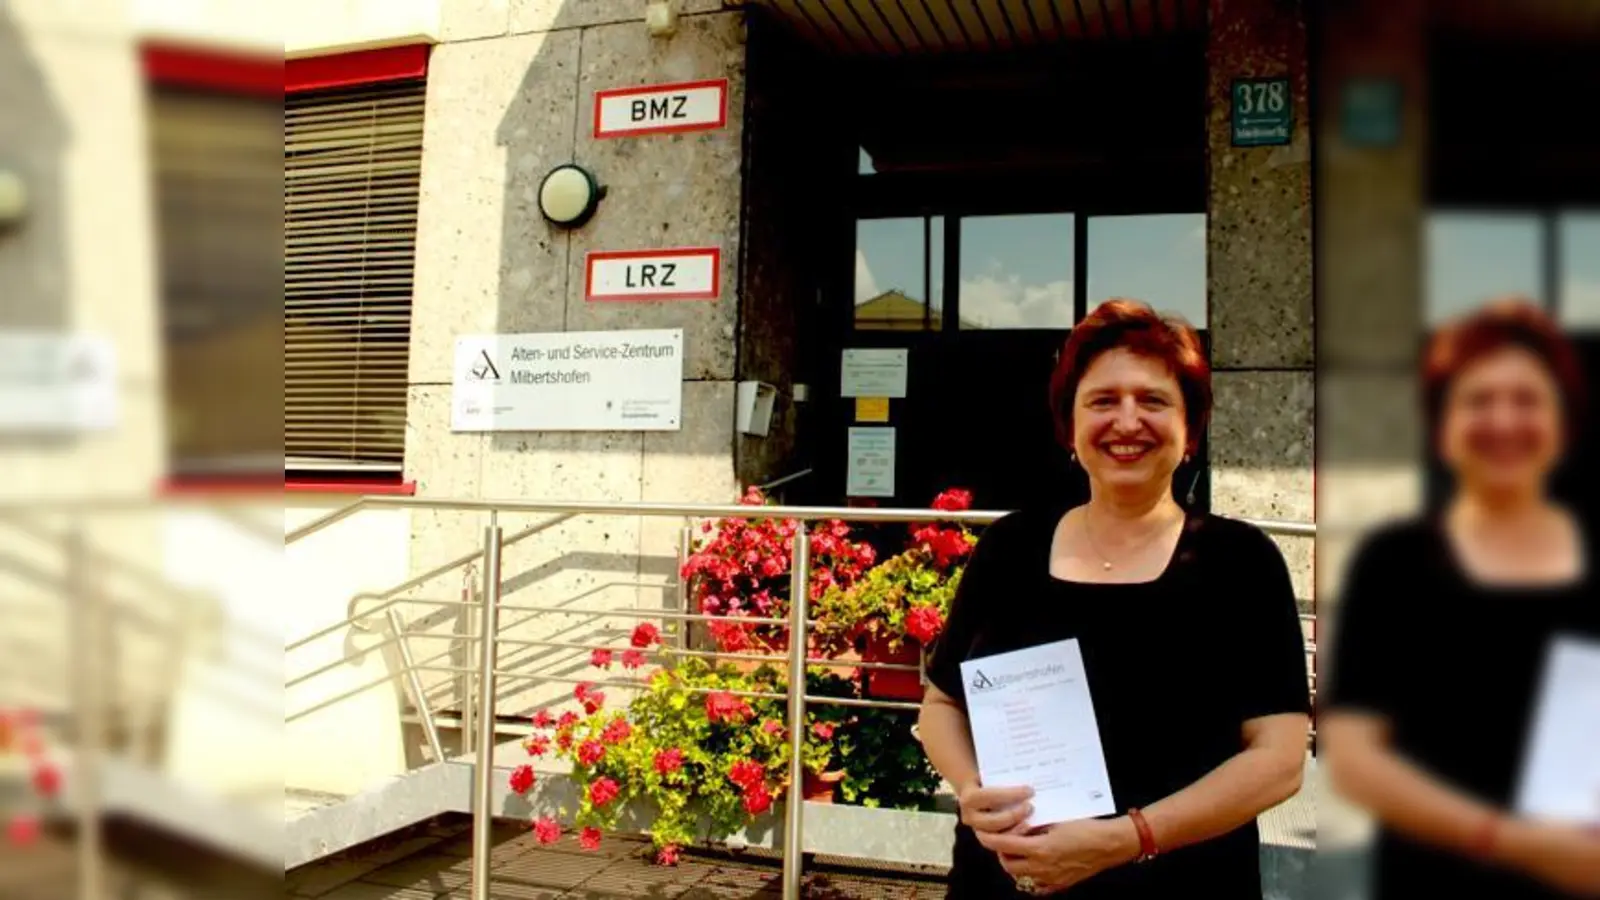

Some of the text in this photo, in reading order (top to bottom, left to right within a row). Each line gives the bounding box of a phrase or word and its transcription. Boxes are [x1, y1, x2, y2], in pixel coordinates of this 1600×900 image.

[631, 96, 687, 121] BMZ
[1238, 83, 1284, 113] 378
[625, 264, 676, 287] LRZ
[511, 344, 674, 361] Alten- und Service-Zentrum
[510, 370, 591, 384] Milbertshofen
